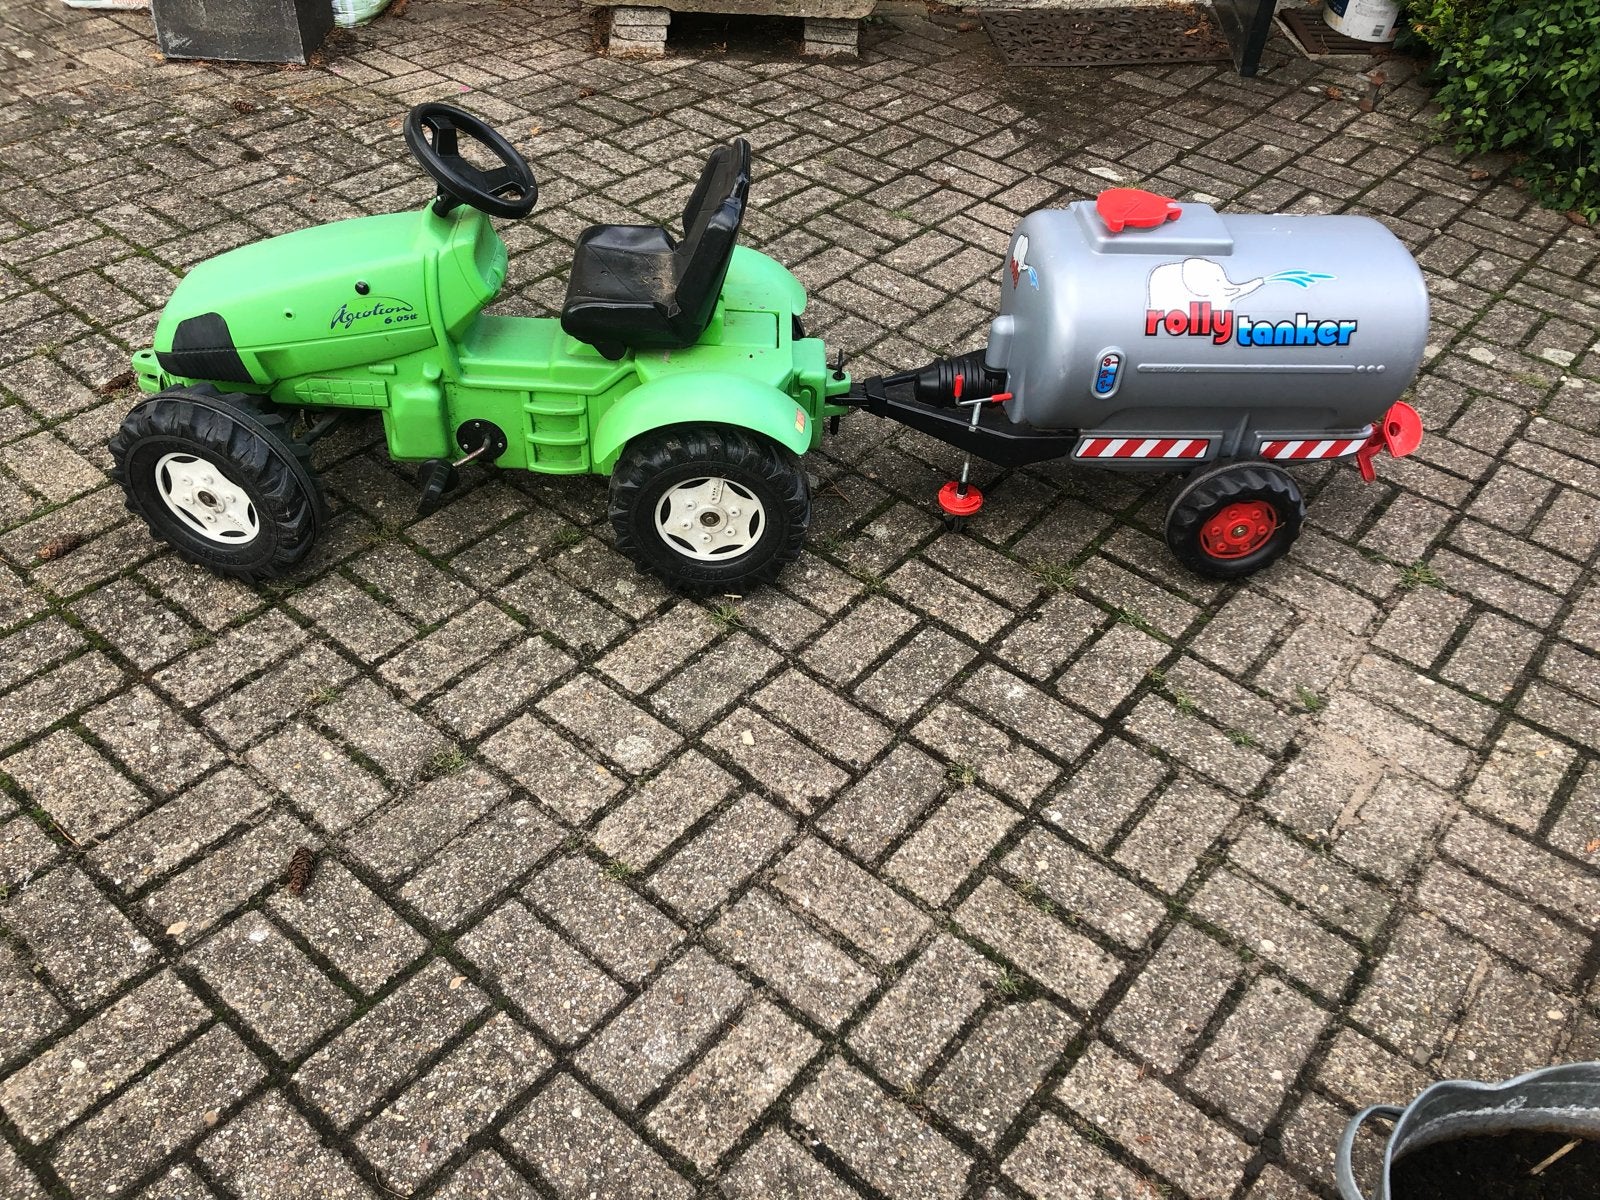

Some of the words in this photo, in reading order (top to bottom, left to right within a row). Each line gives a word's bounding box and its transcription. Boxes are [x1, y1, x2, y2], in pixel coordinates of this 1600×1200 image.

[1144, 301, 1234, 345] rolly
[1236, 312, 1358, 347] tanker
[1104, 358, 1111, 367] 3
